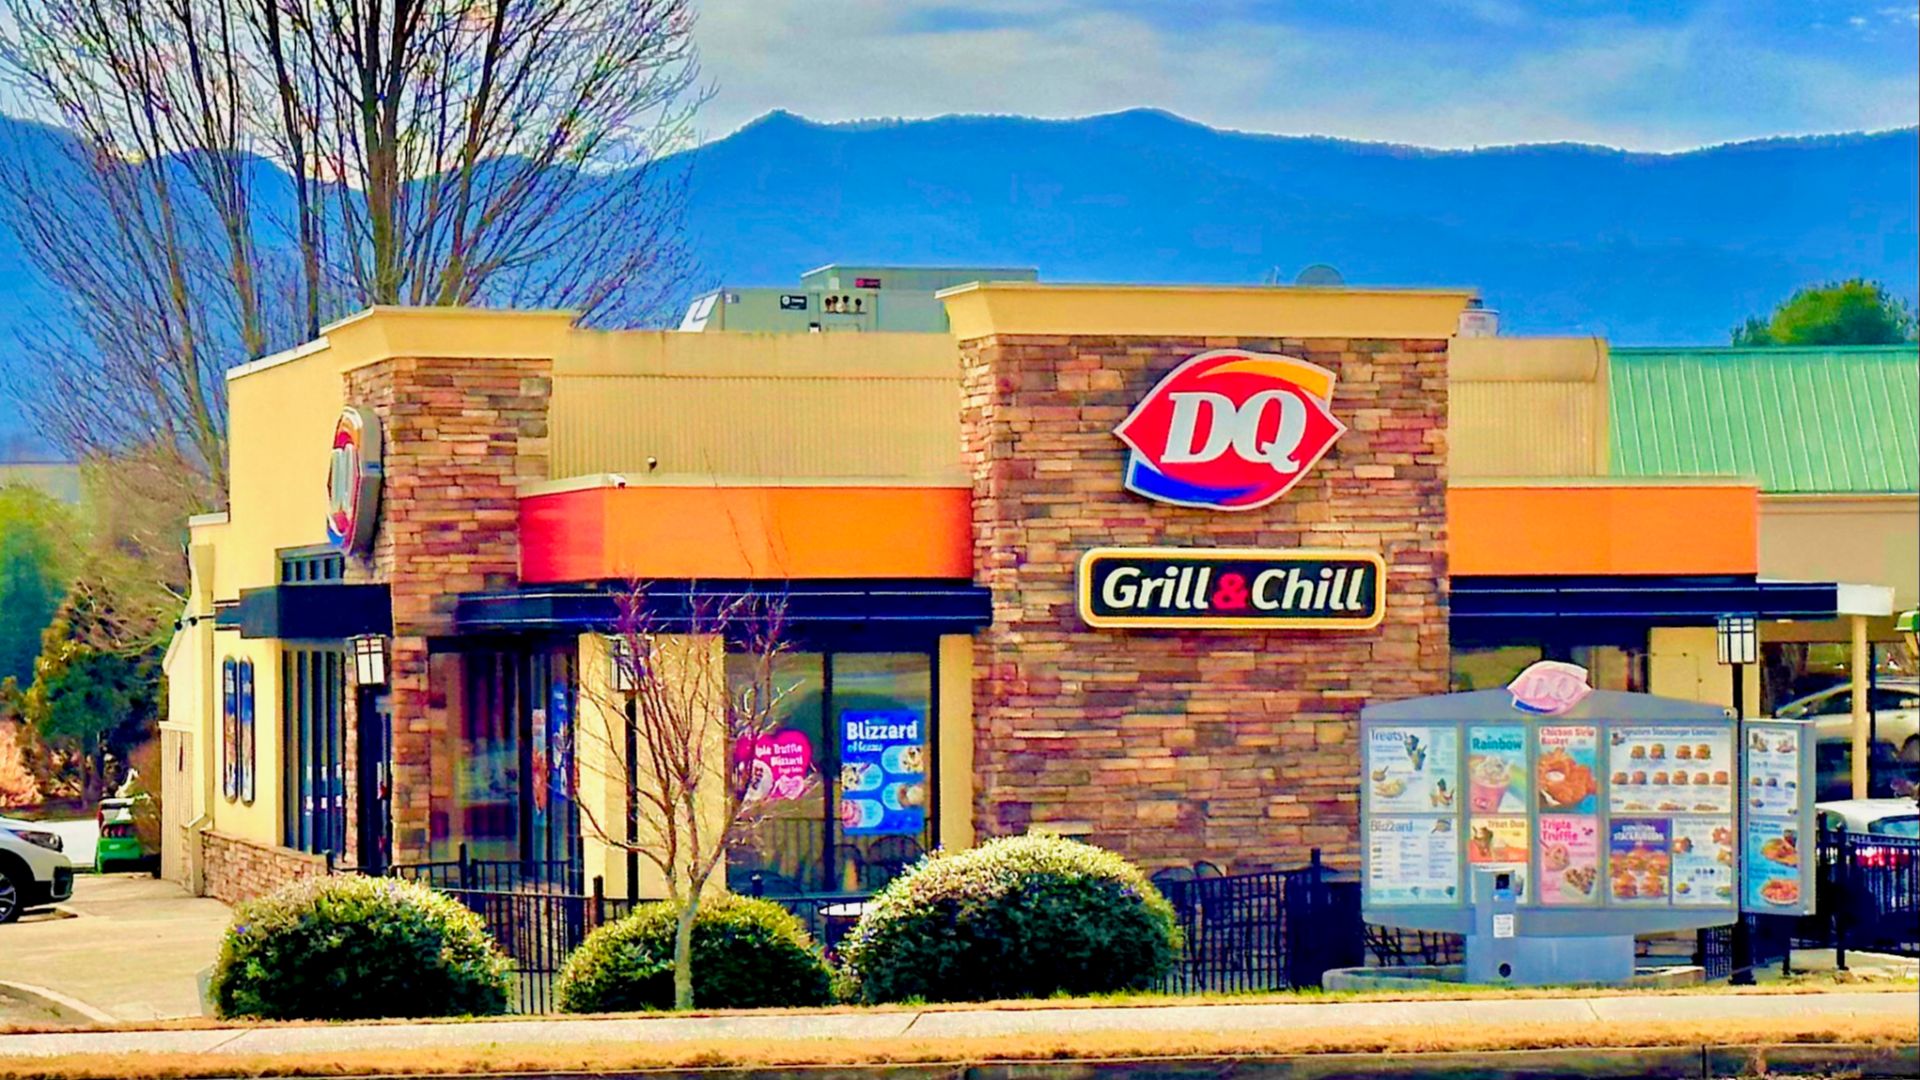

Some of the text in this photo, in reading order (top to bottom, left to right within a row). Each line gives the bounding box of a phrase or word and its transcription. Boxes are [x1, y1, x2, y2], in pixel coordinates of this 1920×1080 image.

[1160, 389, 1308, 474] DQ
[1102, 565, 1366, 611] Grill & Chill
[847, 719, 918, 740] Blizzard
[773, 743, 803, 754] Truffle
[1472, 738, 1522, 751] Rainbow
[770, 756, 803, 767] Blizzard
[1370, 819, 1413, 833] Blizzard
[1542, 831, 1578, 841] Truffle
